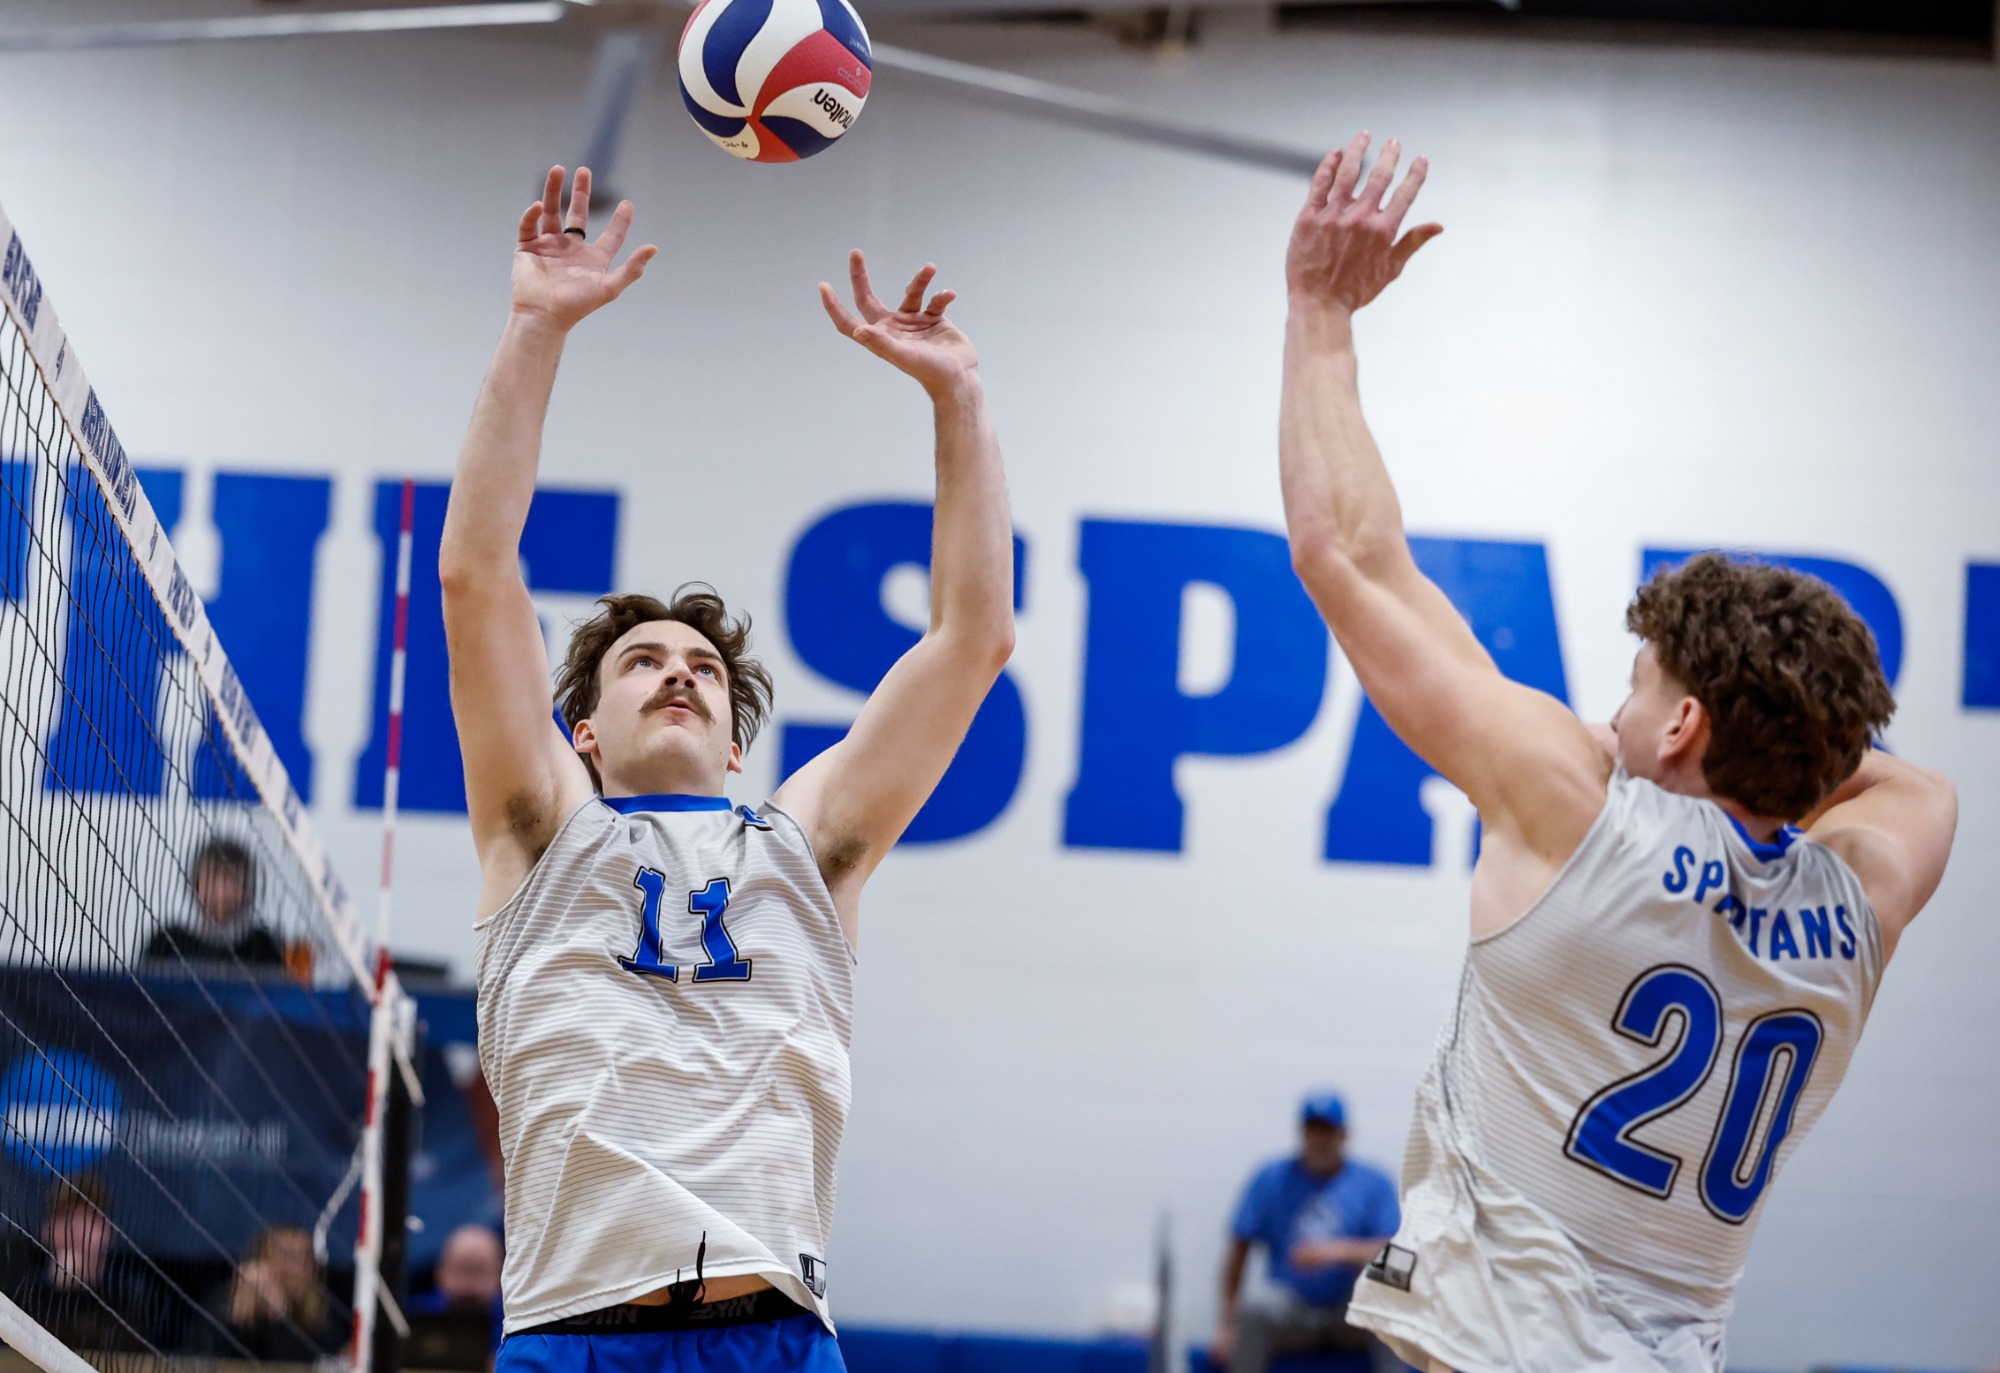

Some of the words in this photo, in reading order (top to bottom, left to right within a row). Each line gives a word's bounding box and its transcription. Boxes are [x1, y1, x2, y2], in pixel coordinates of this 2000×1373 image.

[814, 88, 854, 129] molten
[618, 866, 752, 983] 11
[1563, 963, 1824, 1226] 20
